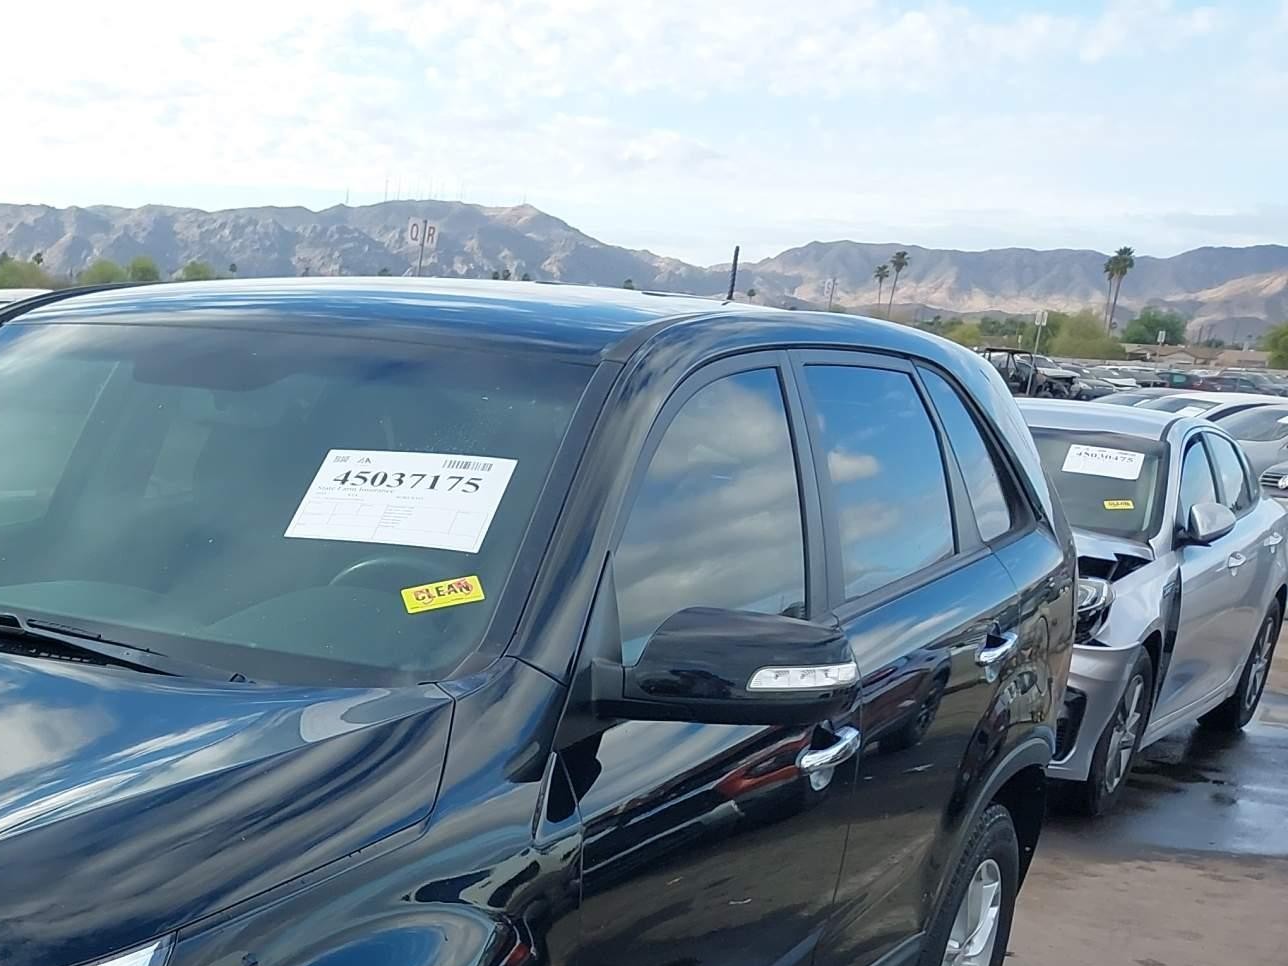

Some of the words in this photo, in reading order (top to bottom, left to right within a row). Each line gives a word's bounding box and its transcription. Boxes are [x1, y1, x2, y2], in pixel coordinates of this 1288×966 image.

[410, 223, 419, 241] Q
[427, 226, 436, 244] R
[333, 470, 483, 494] 45037175
[414, 580, 473, 601] CLEAN
